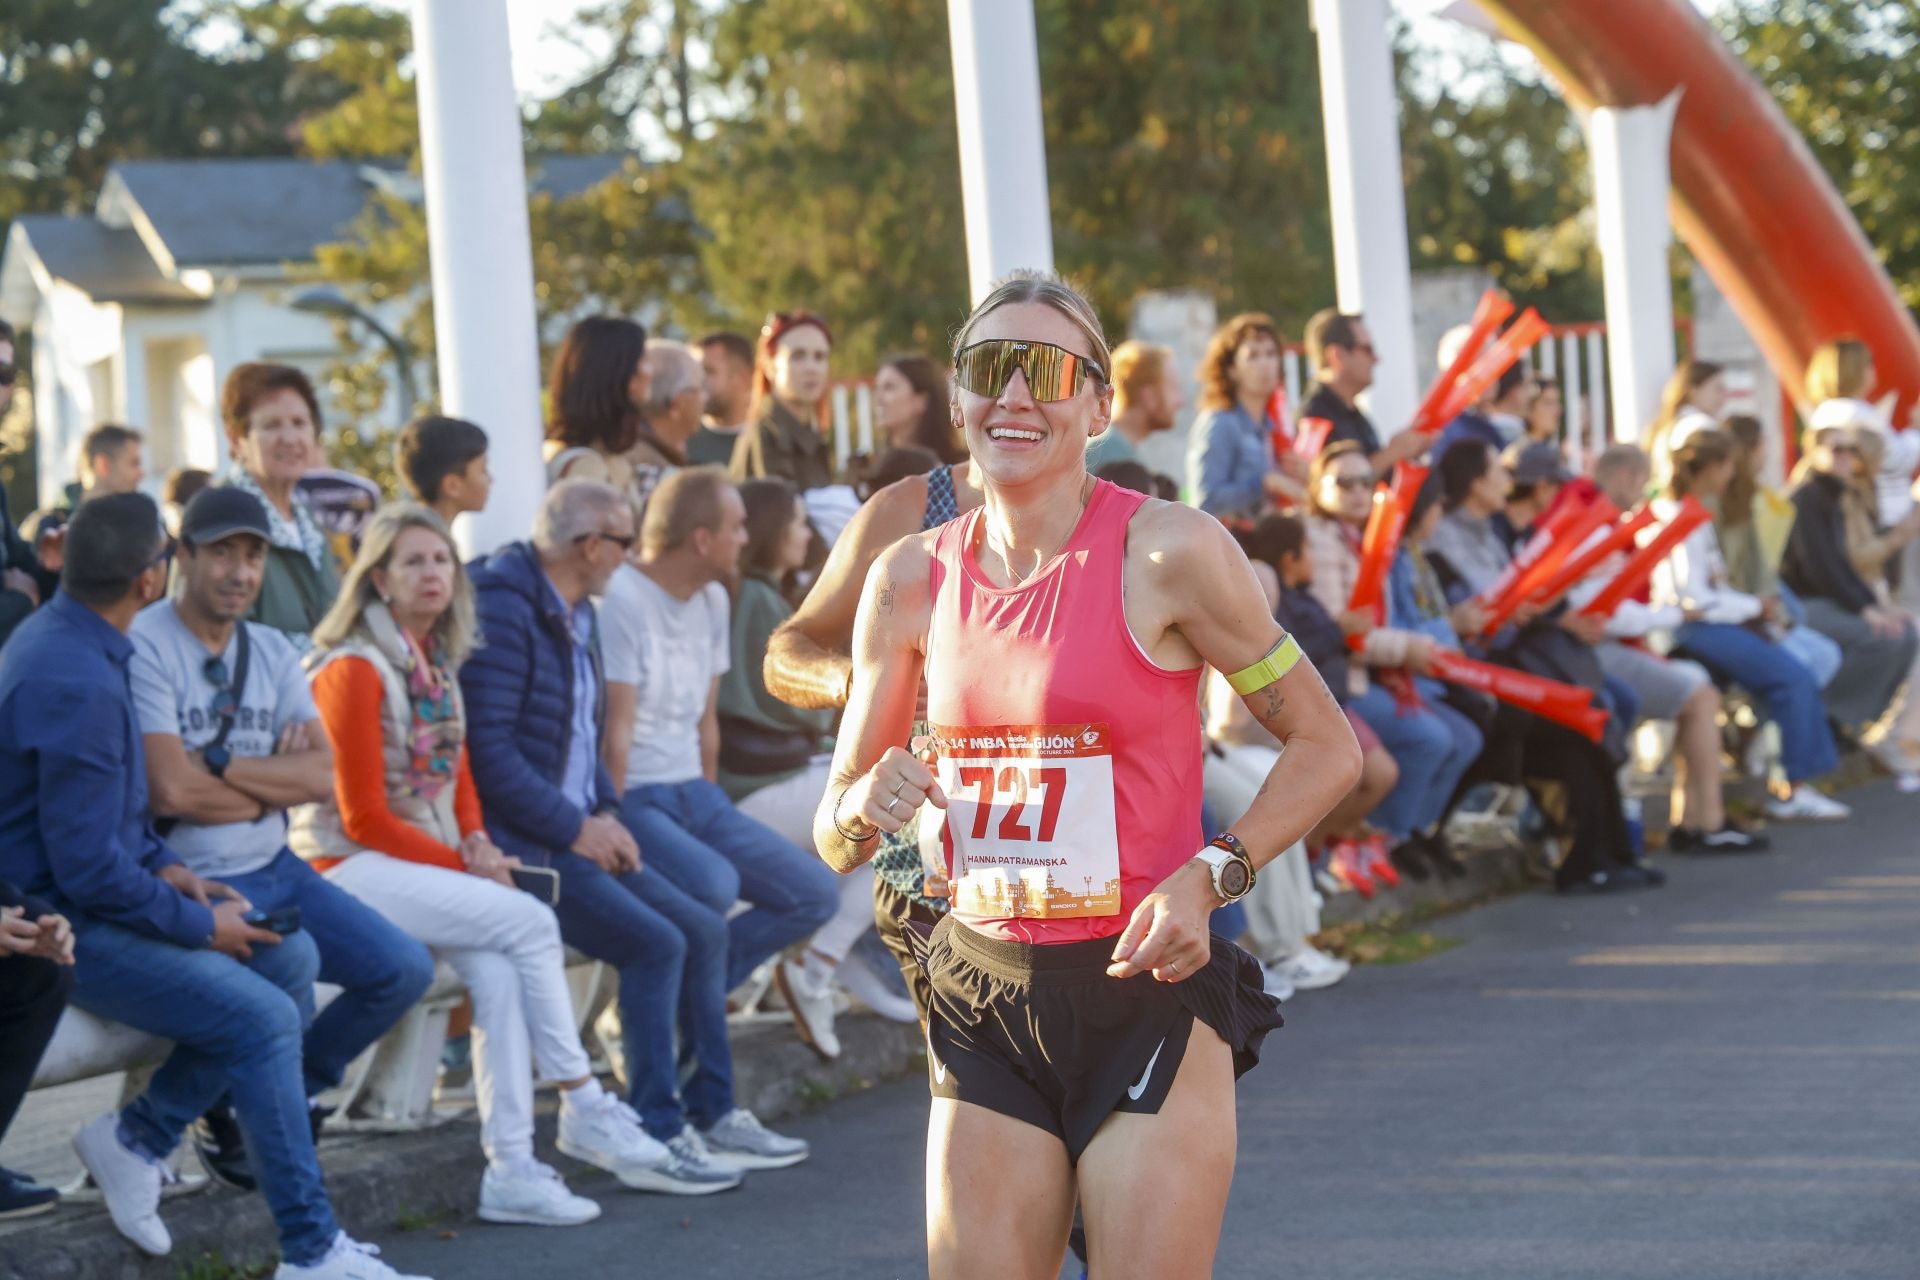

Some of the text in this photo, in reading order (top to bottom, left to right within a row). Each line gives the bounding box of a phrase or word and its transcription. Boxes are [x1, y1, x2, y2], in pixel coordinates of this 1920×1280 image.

[970, 737, 1007, 749] MBA
[1033, 734, 1075, 749] GIJÓN
[959, 766, 1067, 842] 727
[967, 855, 1067, 867] HANNA PATRAMANSKA
